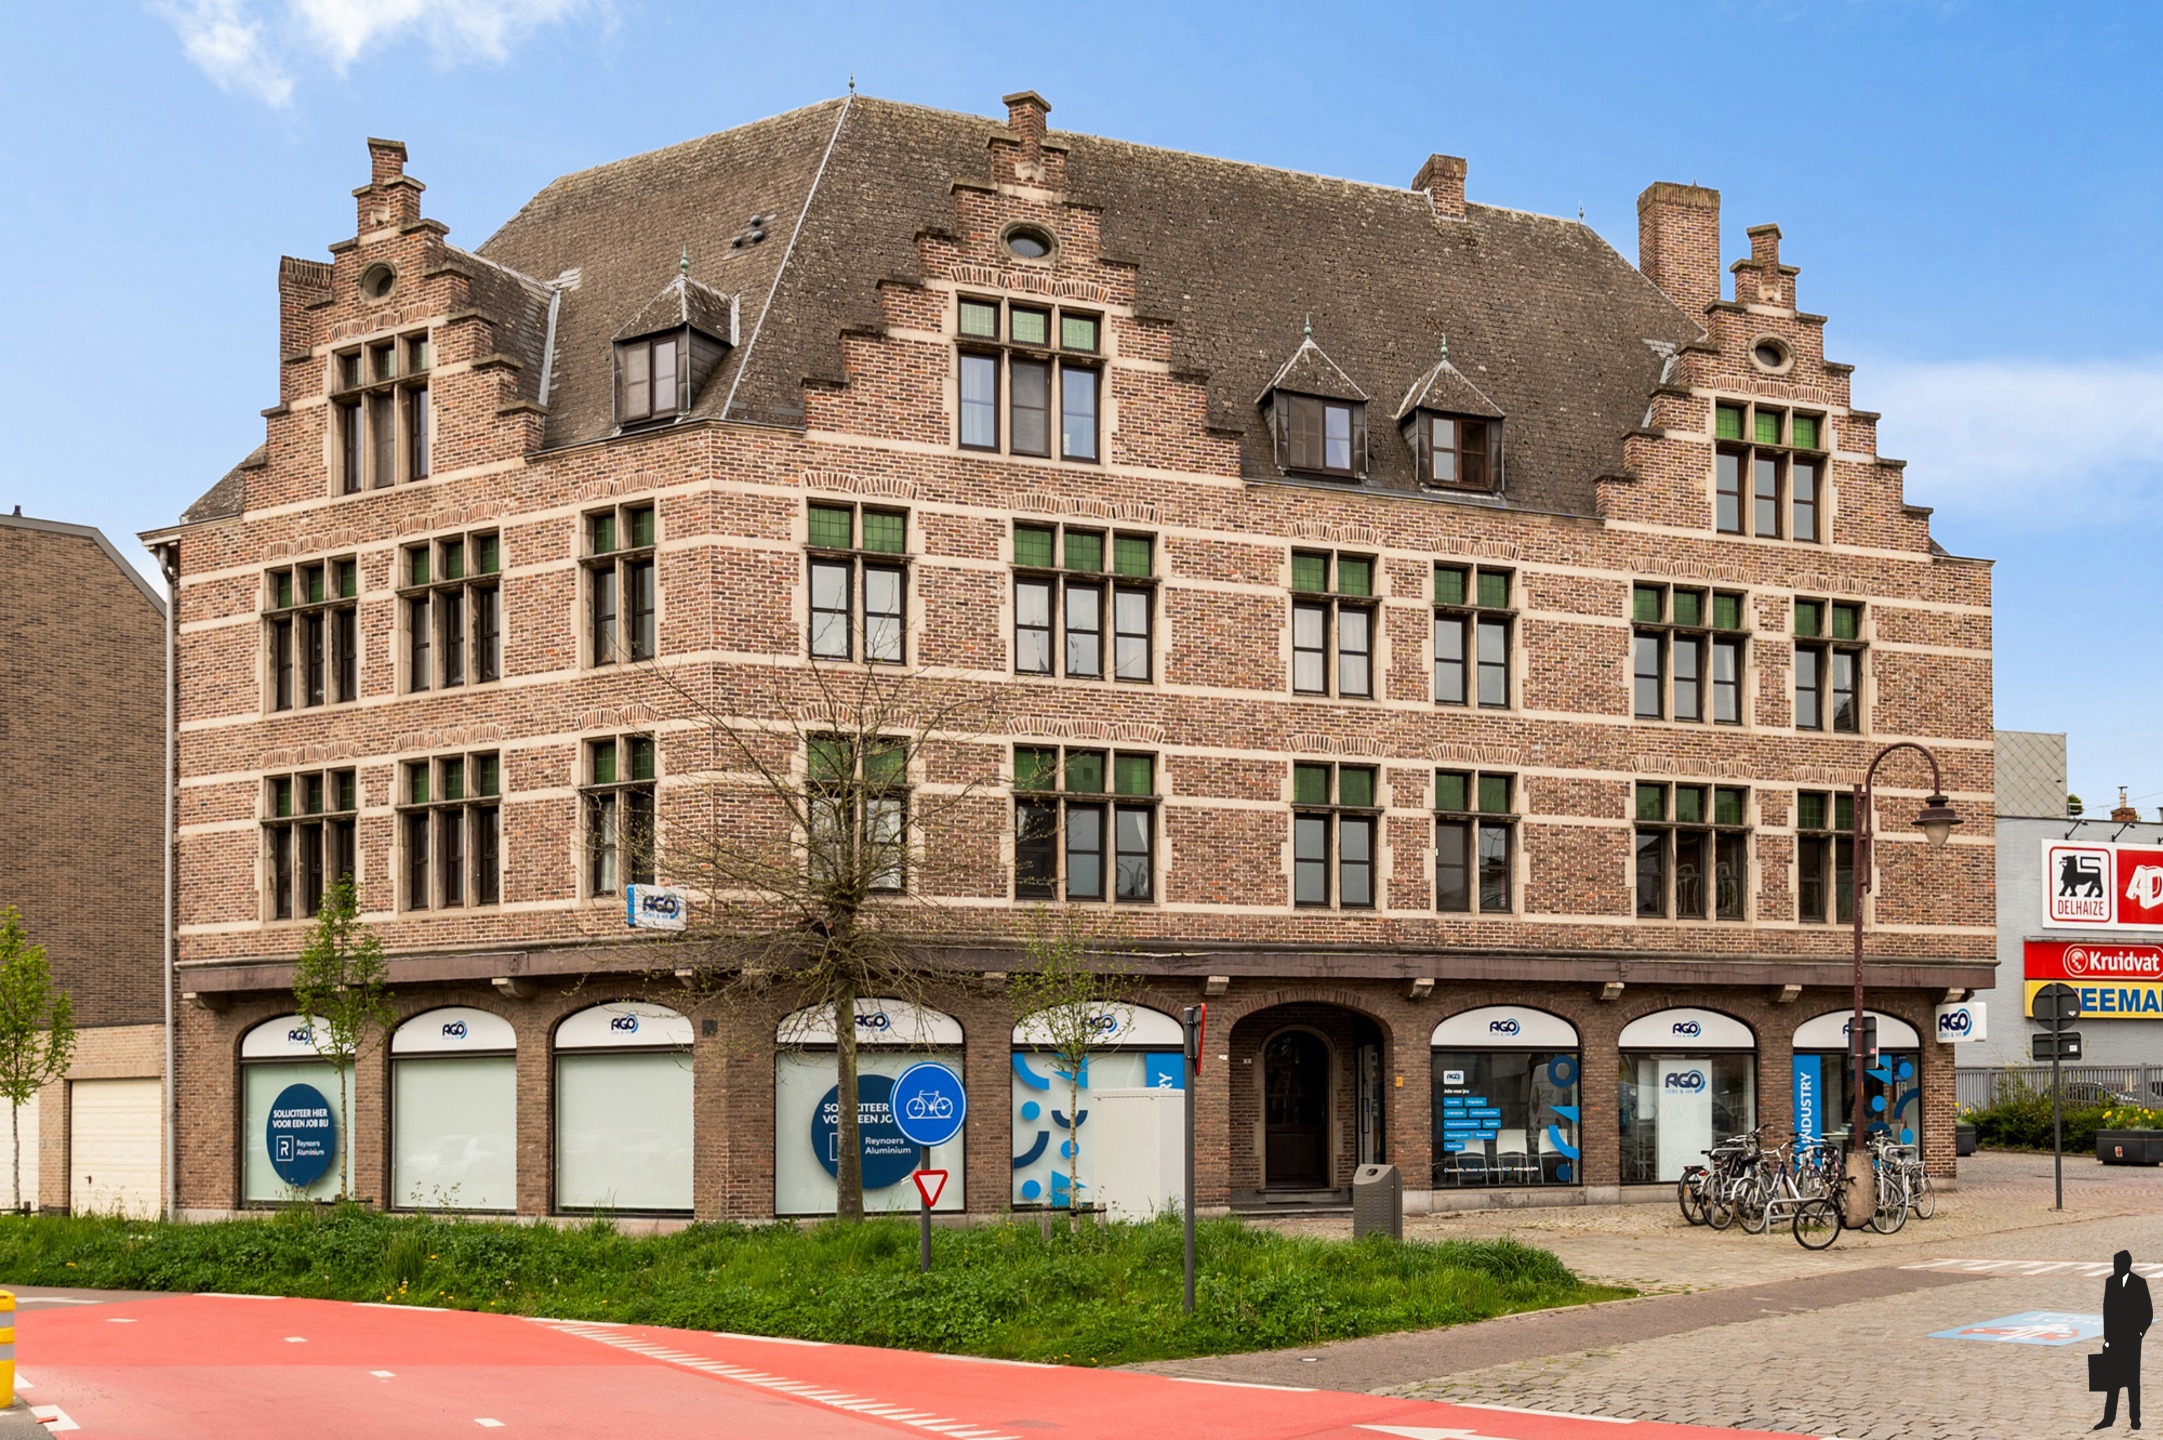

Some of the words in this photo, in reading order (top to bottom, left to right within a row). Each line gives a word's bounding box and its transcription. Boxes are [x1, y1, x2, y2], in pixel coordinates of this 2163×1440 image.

[2058, 900, 2104, 916] DELHAIZE
[2090, 951, 2159, 972] Kruidvat
[2074, 988, 2163, 1012] EEMA
[611, 1016, 637, 1030] AGO
[1490, 1020, 1518, 1033] AGO
[1672, 1022, 1699, 1034] AGO
[1939, 1012, 1969, 1031] AGO
[442, 1022, 466, 1036] AGO
[1665, 1071, 1703, 1088] AGO
[273, 1109, 311, 1118] SOLLICITEER
[312, 1109, 328, 1117] HIER
[272, 1120, 291, 1128] VOOR
[293, 1120, 305, 1128] EEN
[306, 1120, 318, 1128] JOB
[865, 1137, 904, 1145] Reynaers
[280, 1141, 289, 1156] R
[865, 1147, 911, 1155] Aluminium
